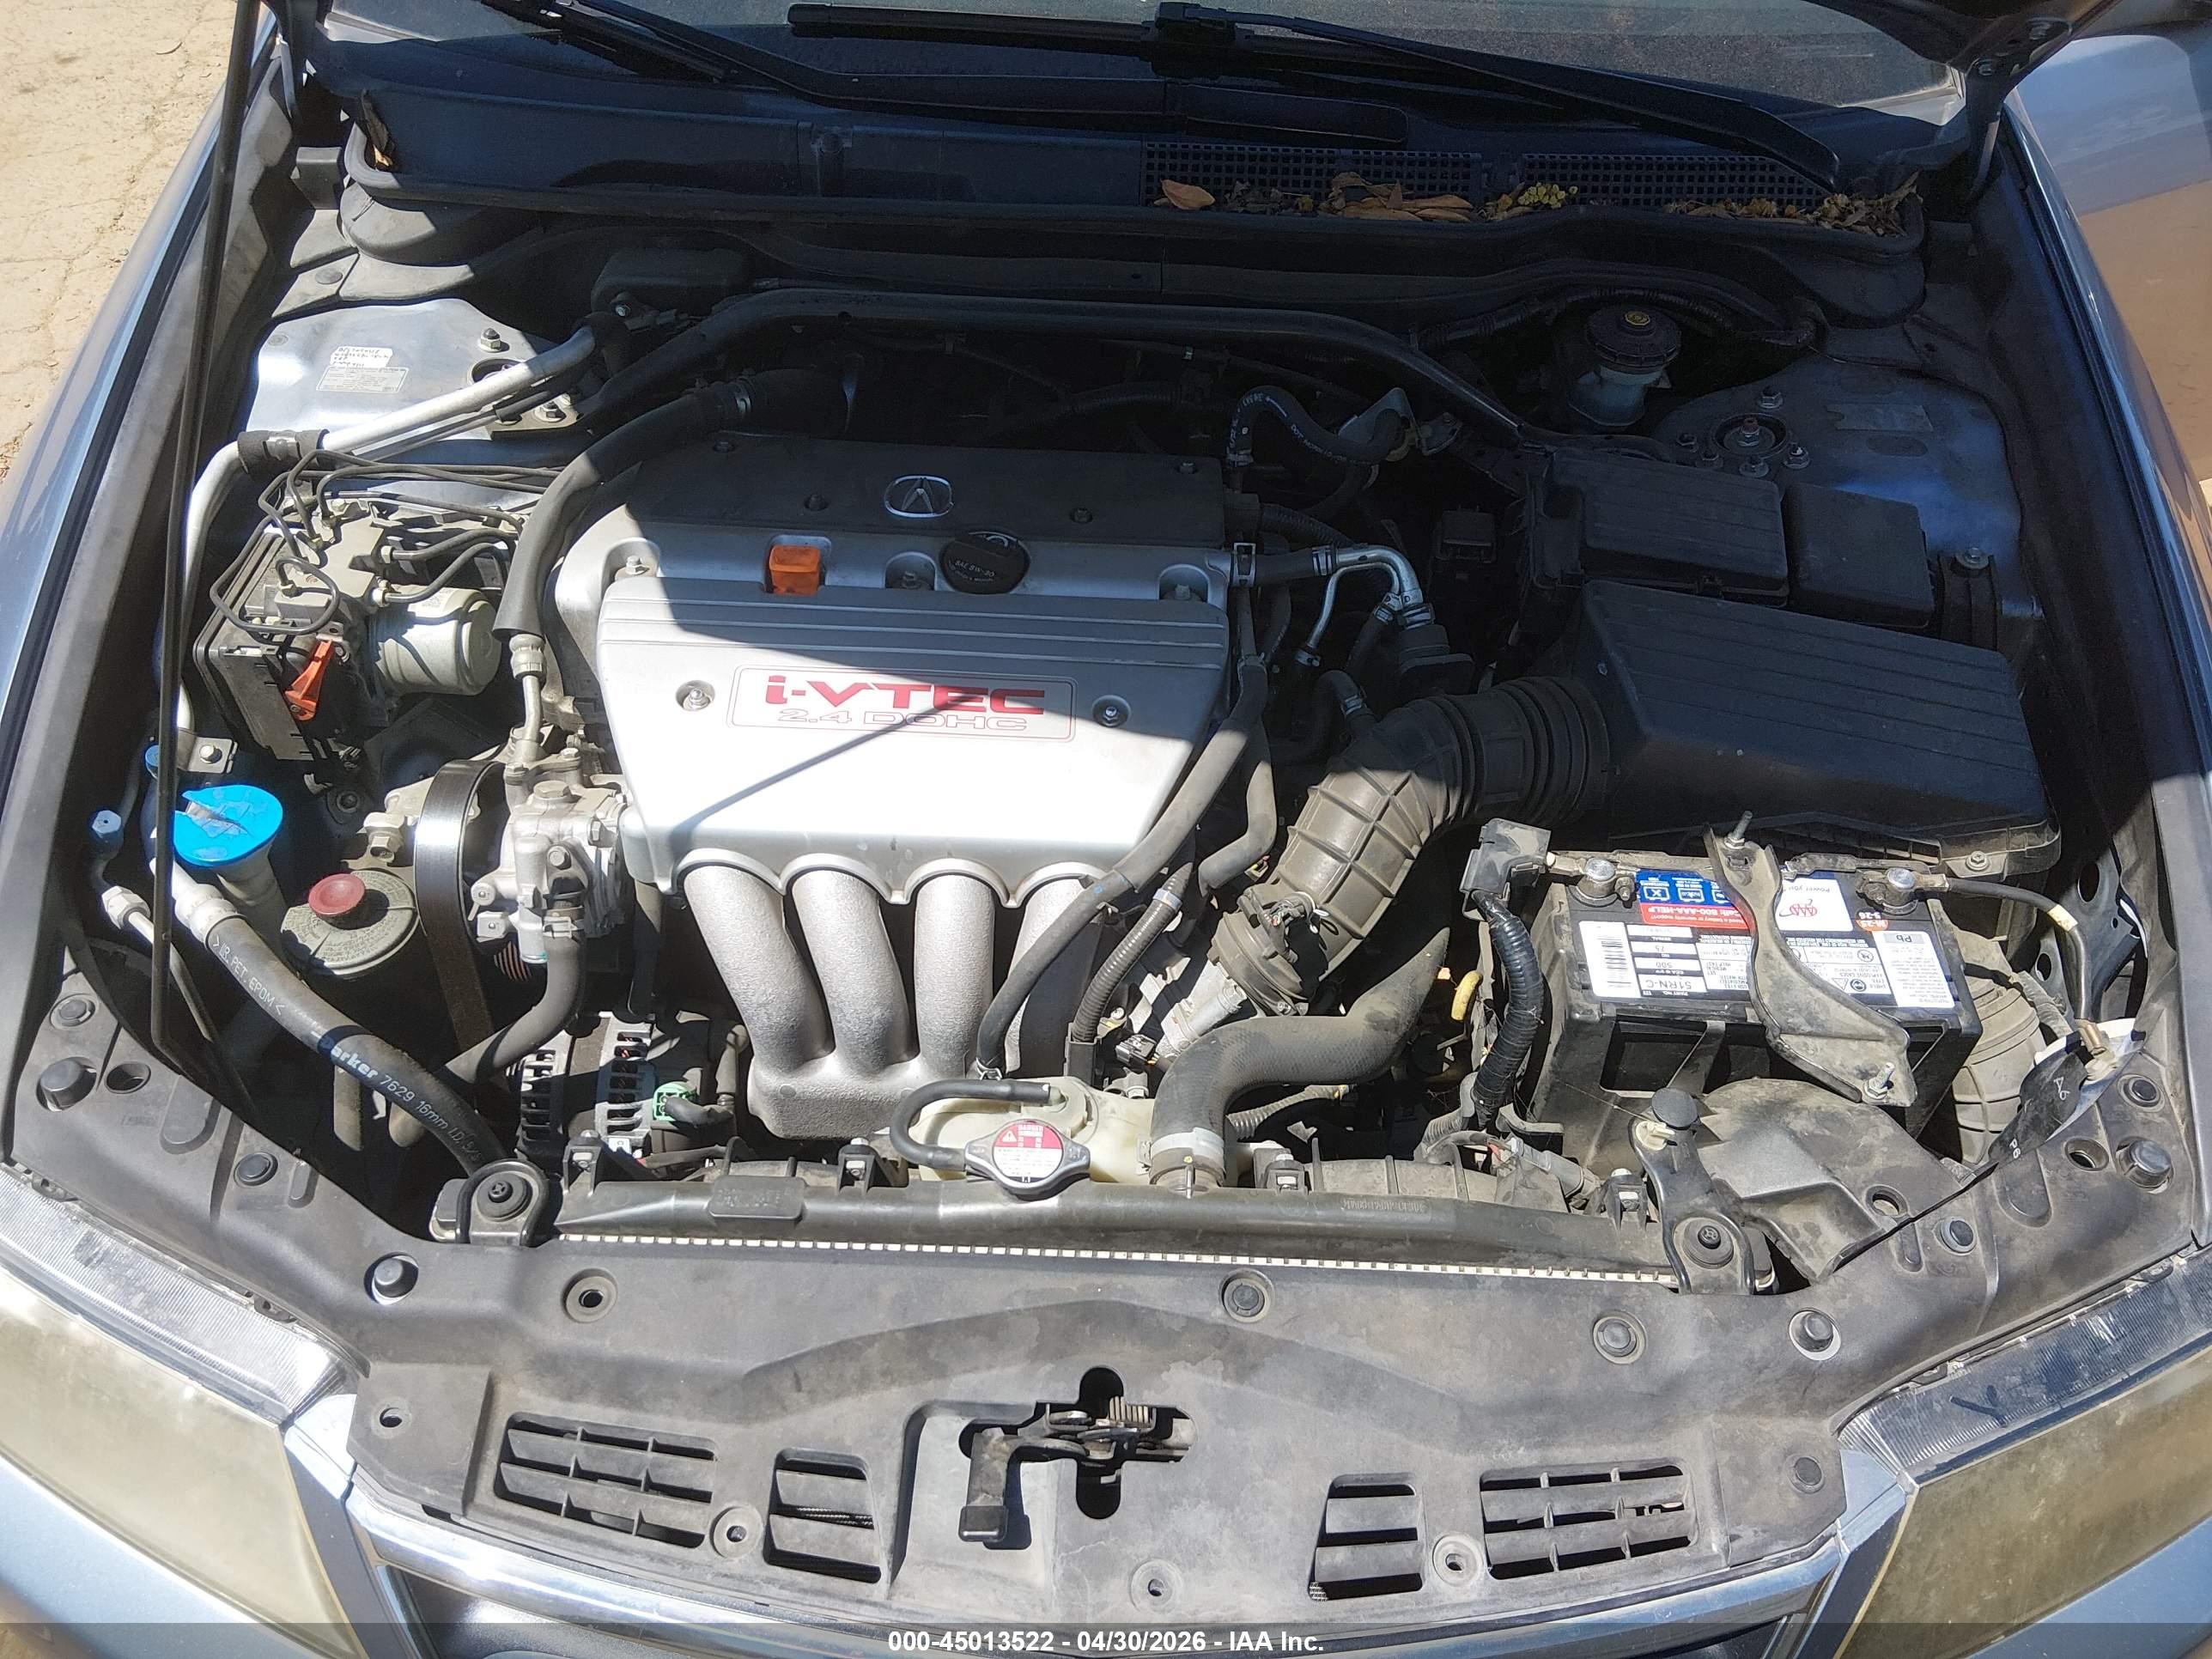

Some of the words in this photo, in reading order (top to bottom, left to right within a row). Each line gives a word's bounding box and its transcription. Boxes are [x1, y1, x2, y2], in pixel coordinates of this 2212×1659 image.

[766, 676, 1045, 715] i-VTEC
[777, 708, 853, 724] 2.4
[863, 710, 1028, 732] DOHC
[1648, 906, 1718, 917] 800-AAA-HELP
[1896, 934, 1912, 943] Pb
[1645, 978, 1692, 989] 51RN-C
[319, 1036, 379, 1079] Parker
[380, 1074, 416, 1103] 7629
[415, 1100, 449, 1130] 16mm
